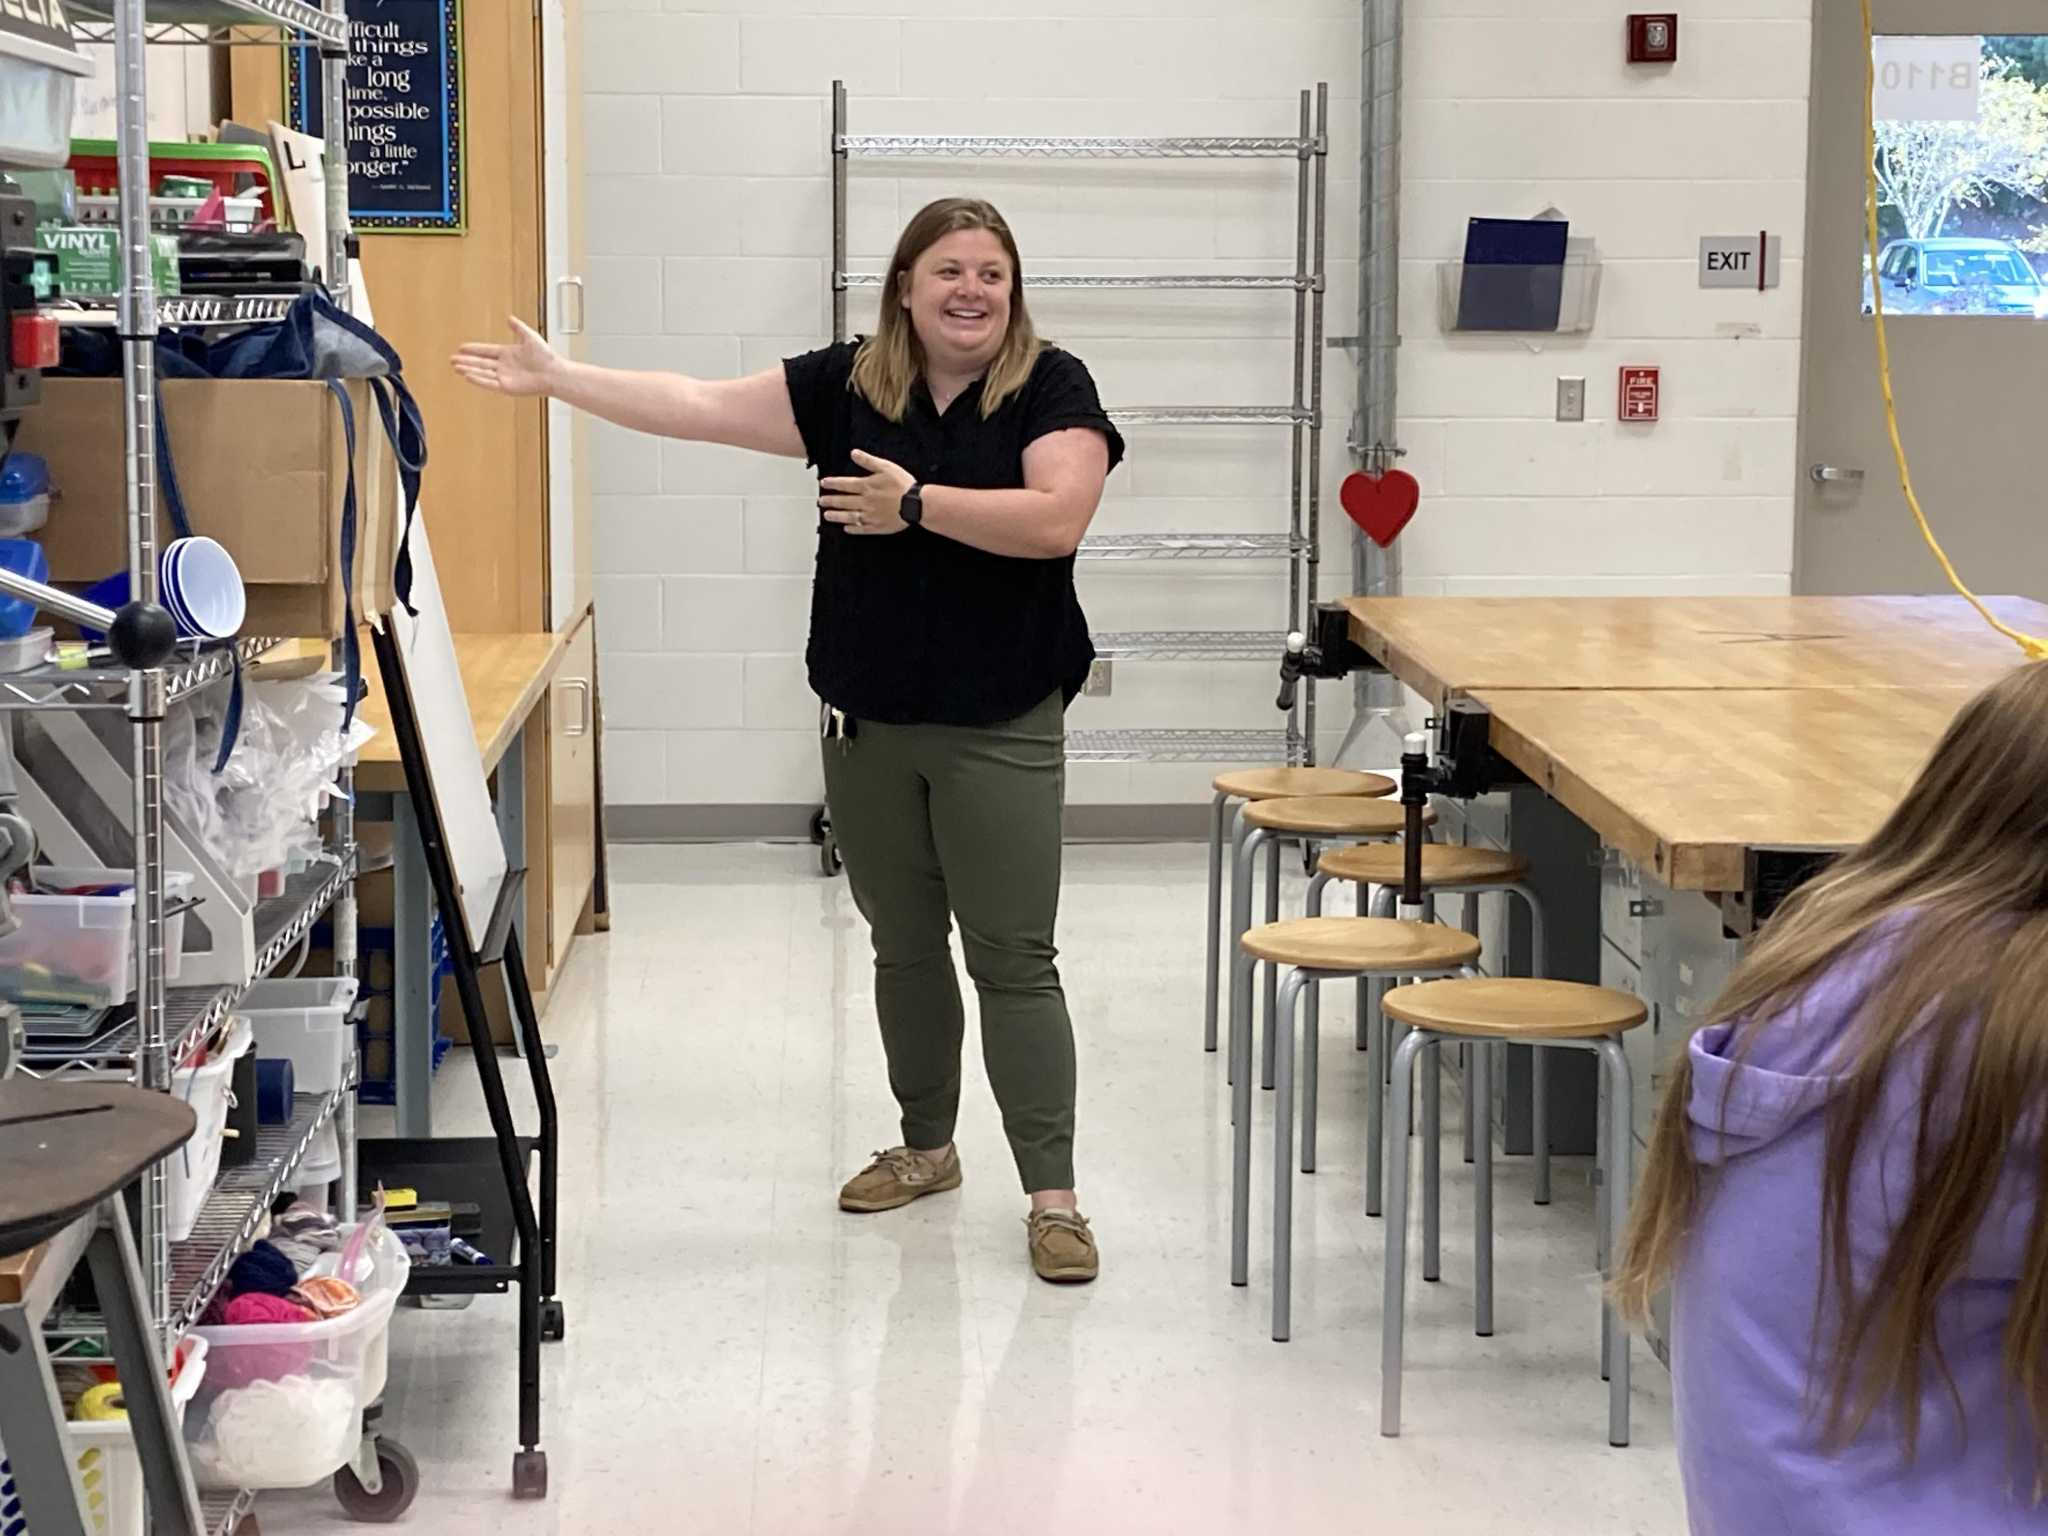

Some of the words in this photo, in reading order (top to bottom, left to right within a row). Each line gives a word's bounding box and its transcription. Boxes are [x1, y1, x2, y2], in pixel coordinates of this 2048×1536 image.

[355, 39, 428, 57] things
[344, 52, 368, 66] ke
[371, 54, 383, 66] a
[367, 66, 411, 93] long
[370, 146, 380, 158] a
[384, 144, 418, 159] little
[44, 233, 111, 249] VINYL
[1707, 252, 1751, 270] EXIT
